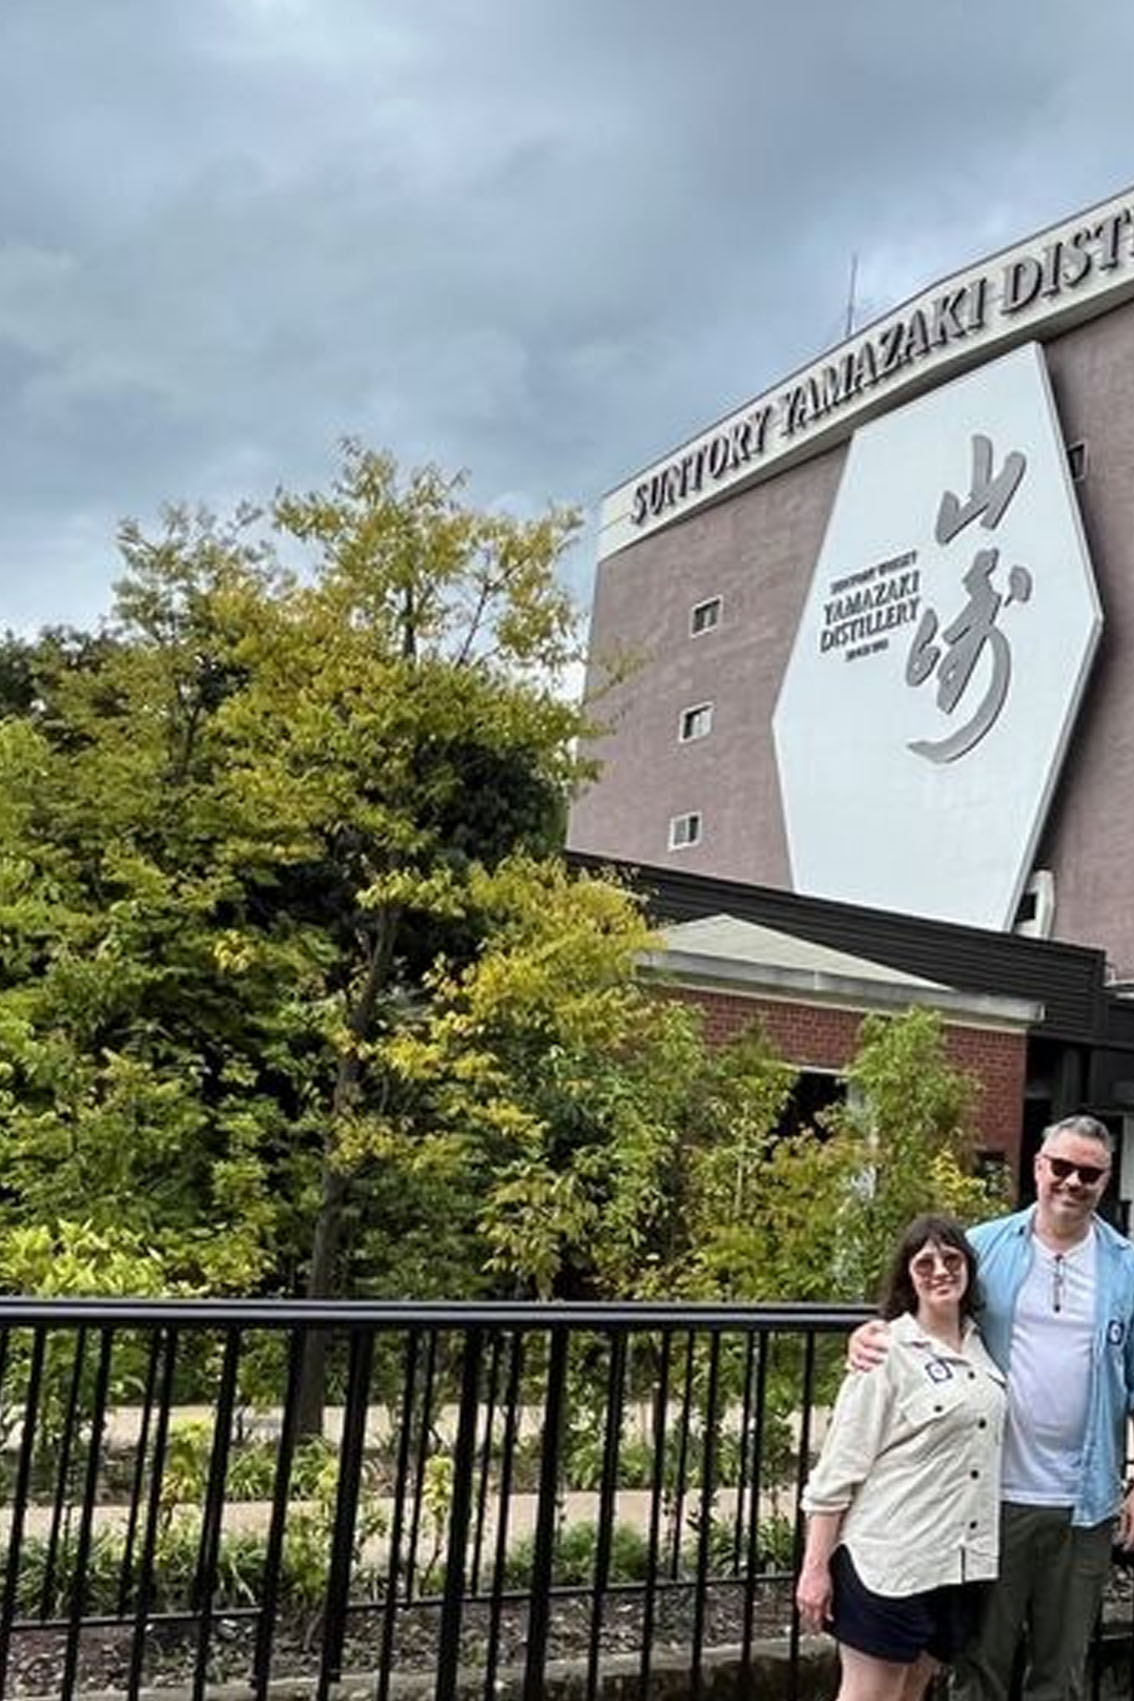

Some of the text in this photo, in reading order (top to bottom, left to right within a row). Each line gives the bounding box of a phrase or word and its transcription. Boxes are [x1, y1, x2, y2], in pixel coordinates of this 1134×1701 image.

[631, 406, 772, 525] SUNTORY
[780, 276, 987, 436] YAMAZAKI
[819, 595, 921, 653] DISTILLERY
[823, 569, 920, 626] YAMAZAKI
